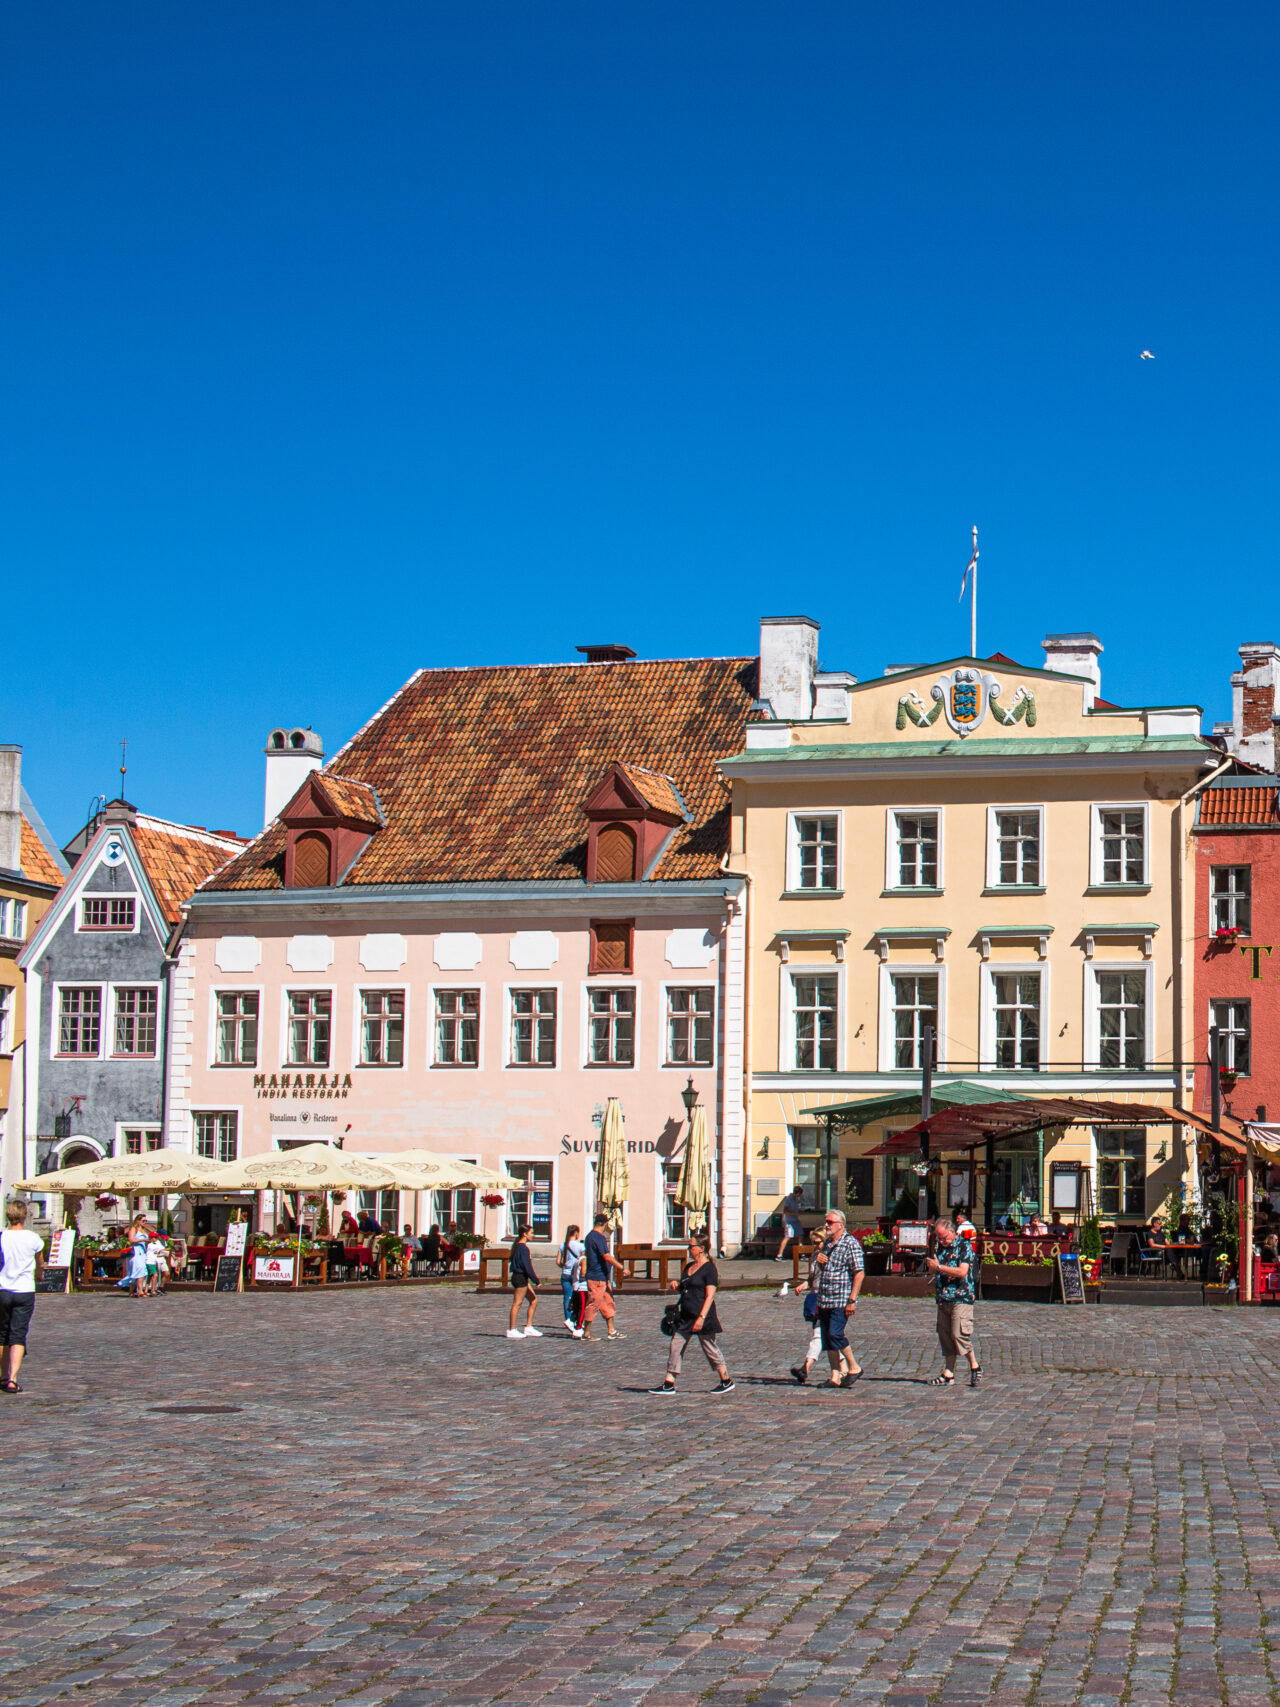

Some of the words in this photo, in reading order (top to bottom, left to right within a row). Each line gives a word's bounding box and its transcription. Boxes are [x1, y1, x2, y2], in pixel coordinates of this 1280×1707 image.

[254, 1074, 353, 1089] MAHARAJA
[257, 1089, 288, 1100] INDIA
[292, 1089, 349, 1100] RESTORAN
[257, 1271, 291, 1279] MAHARAJA
